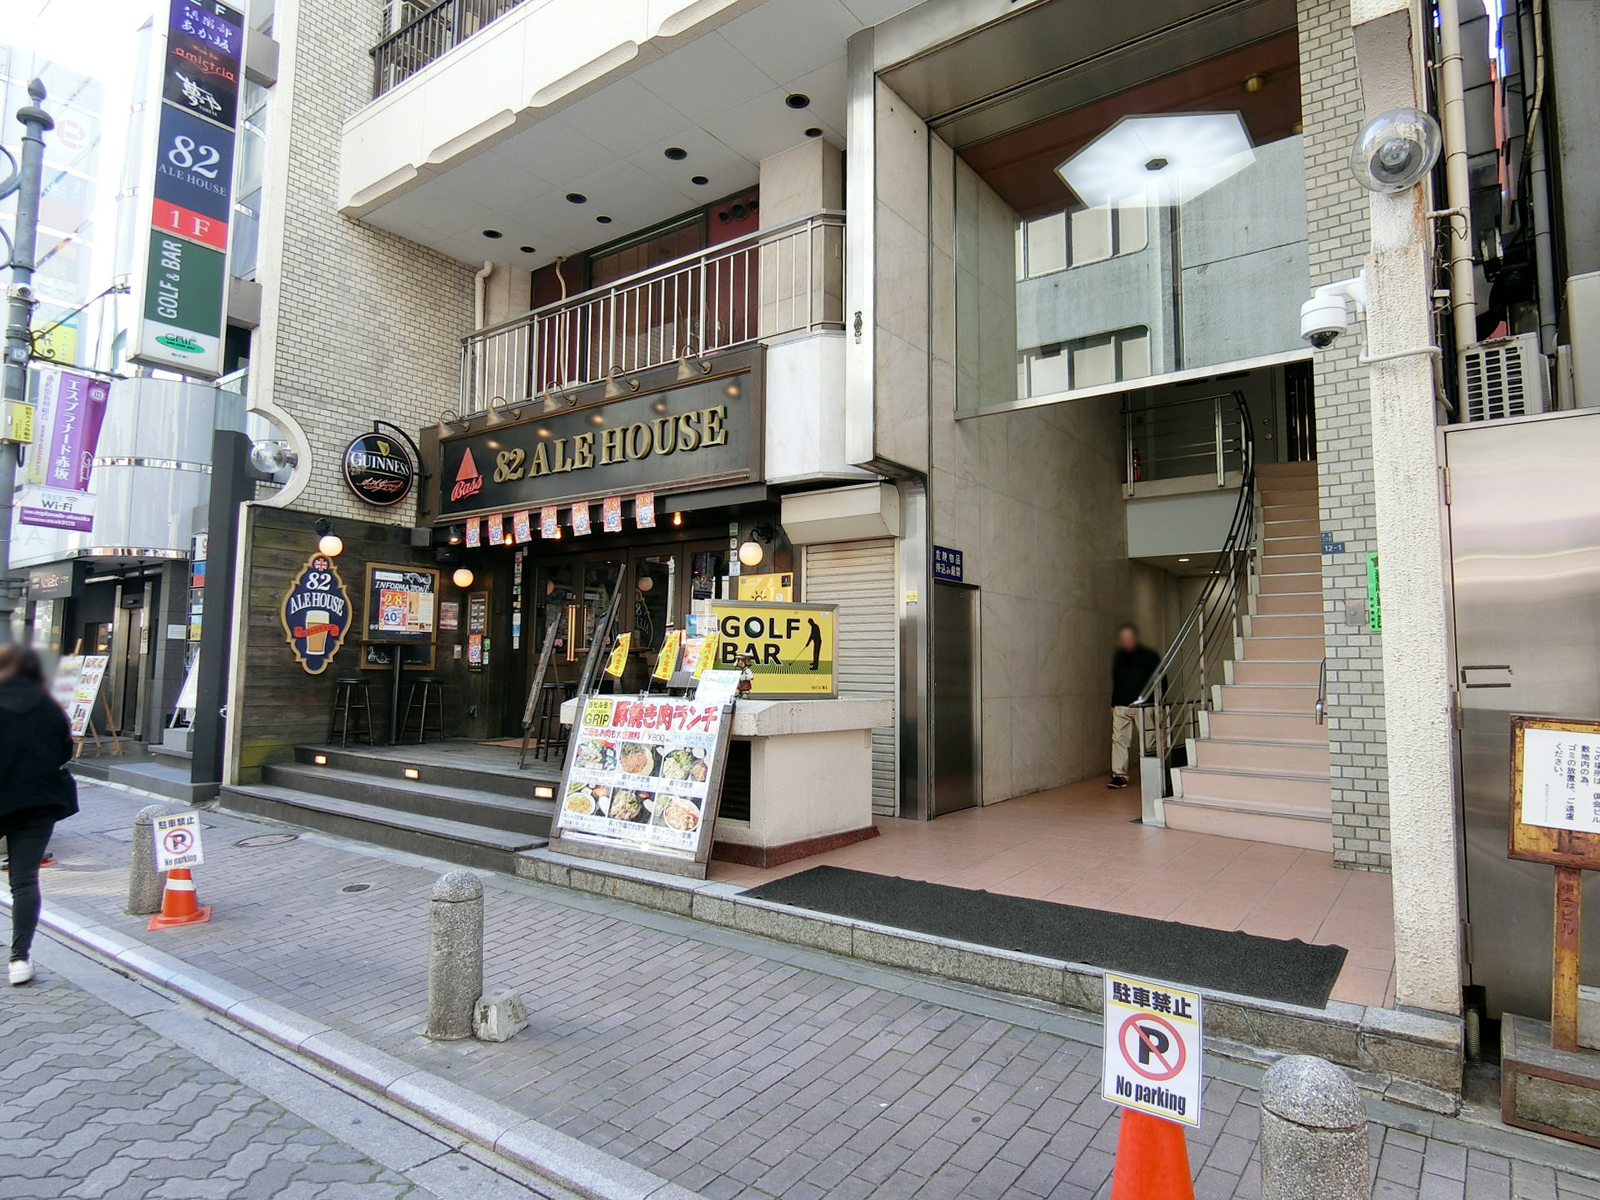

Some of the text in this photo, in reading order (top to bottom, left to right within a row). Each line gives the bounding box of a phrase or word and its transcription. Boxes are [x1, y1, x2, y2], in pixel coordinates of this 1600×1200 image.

[175, 47, 234, 81] amistria
[168, 135, 220, 179] 82
[158, 163, 227, 197] ALE HOUSE
[157, 239, 183, 319] GOLF & BAR
[12, 349, 26, 359] 19
[54, 380, 80, 481] エスプラナード赤坂
[493, 404, 727, 484] 82 ALE HOUSE
[350, 451, 410, 477] GUINNESS
[42, 493, 63, 502] FREE
[450, 475, 484, 502] Bass
[41, 499, 73, 511] Wi-Fi
[306, 572, 333, 591] 82
[290, 592, 345, 617] ALE HOUSE
[384, 612, 398, 622] 40
[720, 615, 801, 640] GOLF
[721, 642, 782, 665] BAR
[584, 713, 611, 726] GRIP
[612, 700, 720, 733] 豚焼き肉ランチ
[158, 815, 195, 830] 駐車禁止
[165, 854, 197, 866] No parking
[1112, 981, 1192, 1020] 駐車禁止
[1116, 1074, 1186, 1116] No parking
